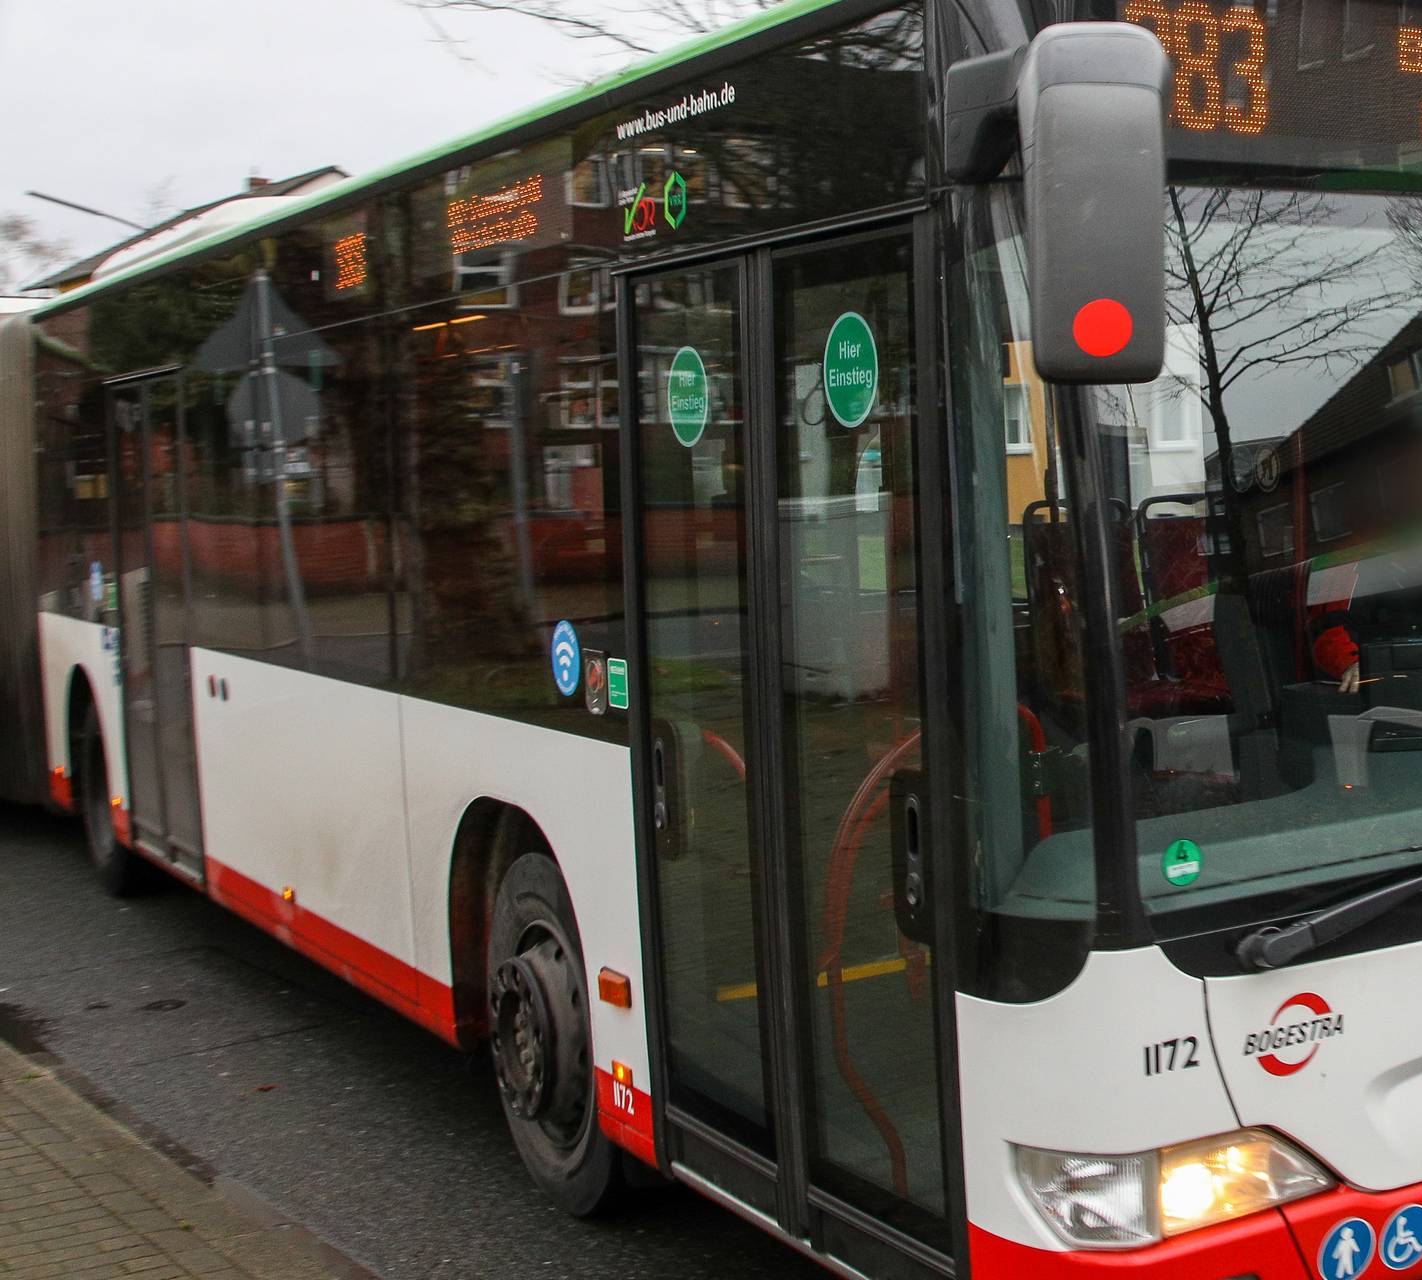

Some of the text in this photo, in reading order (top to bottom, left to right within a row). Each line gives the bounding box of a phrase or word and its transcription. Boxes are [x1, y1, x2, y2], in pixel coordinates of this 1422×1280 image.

[616, 82, 736, 141] www.bus-und-bahn.de
[839, 341, 861, 360] Hier
[679, 374, 695, 387] Hier
[829, 367, 873, 388] Einstieg
[671, 394, 704, 413] Einstieg
[1243, 1014, 1345, 1056] BOGESTRA
[1143, 1035, 1200, 1077] 1172
[613, 1080, 635, 1116] 1172
